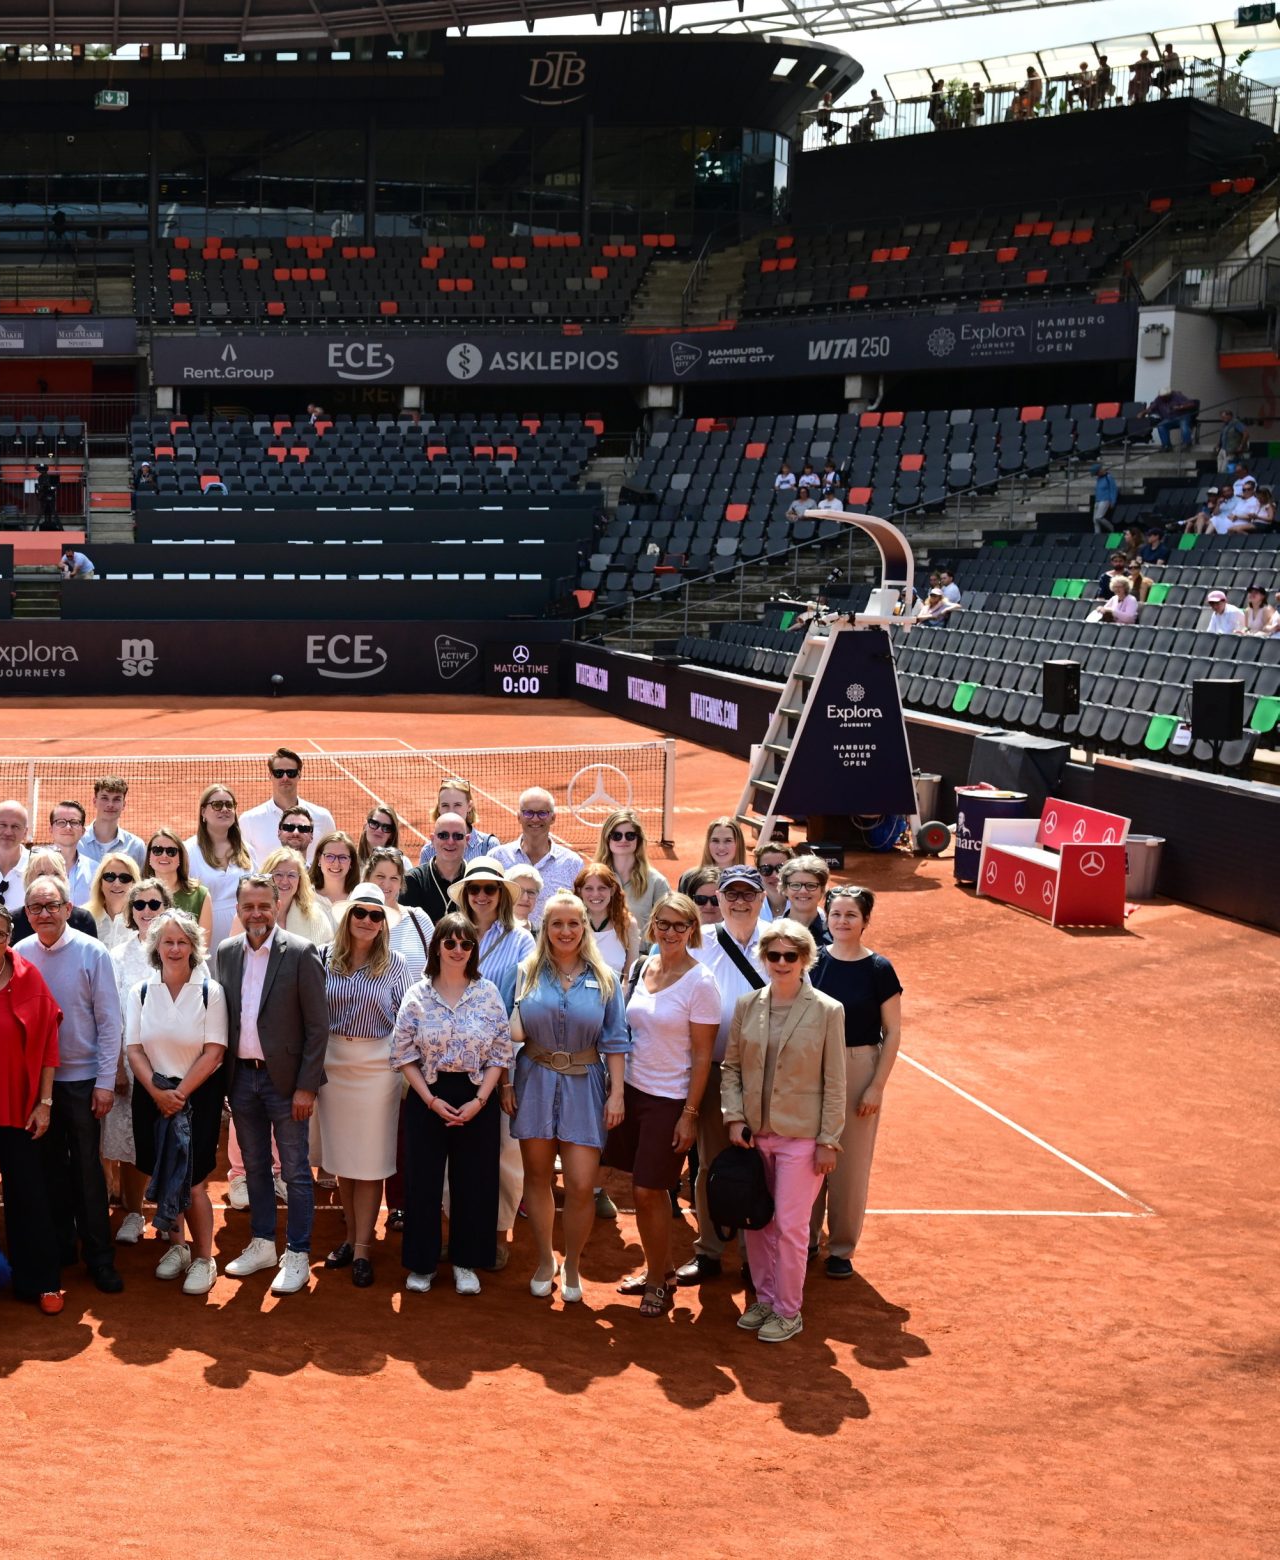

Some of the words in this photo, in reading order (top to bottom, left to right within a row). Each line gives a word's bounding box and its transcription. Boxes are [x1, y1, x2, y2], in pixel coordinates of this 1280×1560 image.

[529, 52, 586, 89] DTB
[1037, 315, 1106, 329] HAMBURG
[961, 322, 1026, 343] Explora
[1037, 329, 1087, 341] LADIES
[708, 347, 763, 357] HAMBURG
[808, 338, 857, 360] WTA
[861, 336, 890, 357] 250
[1036, 342, 1073, 353] OPEN
[328, 343, 383, 368] ECE
[489, 351, 619, 370] ASKLEPIOS
[709, 356, 747, 365] ACTIVE
[749, 355, 775, 363] CITY
[184, 367, 274, 380] Rent.Group
[306, 634, 373, 664] ECE
[441, 652, 470, 660] ACTIVE
[441, 660, 460, 668] CITY
[494, 664, 524, 674] MATCH
[528, 664, 549, 674] TIME
[502, 676, 540, 693] 0:00
[827, 704, 883, 722] Explora
